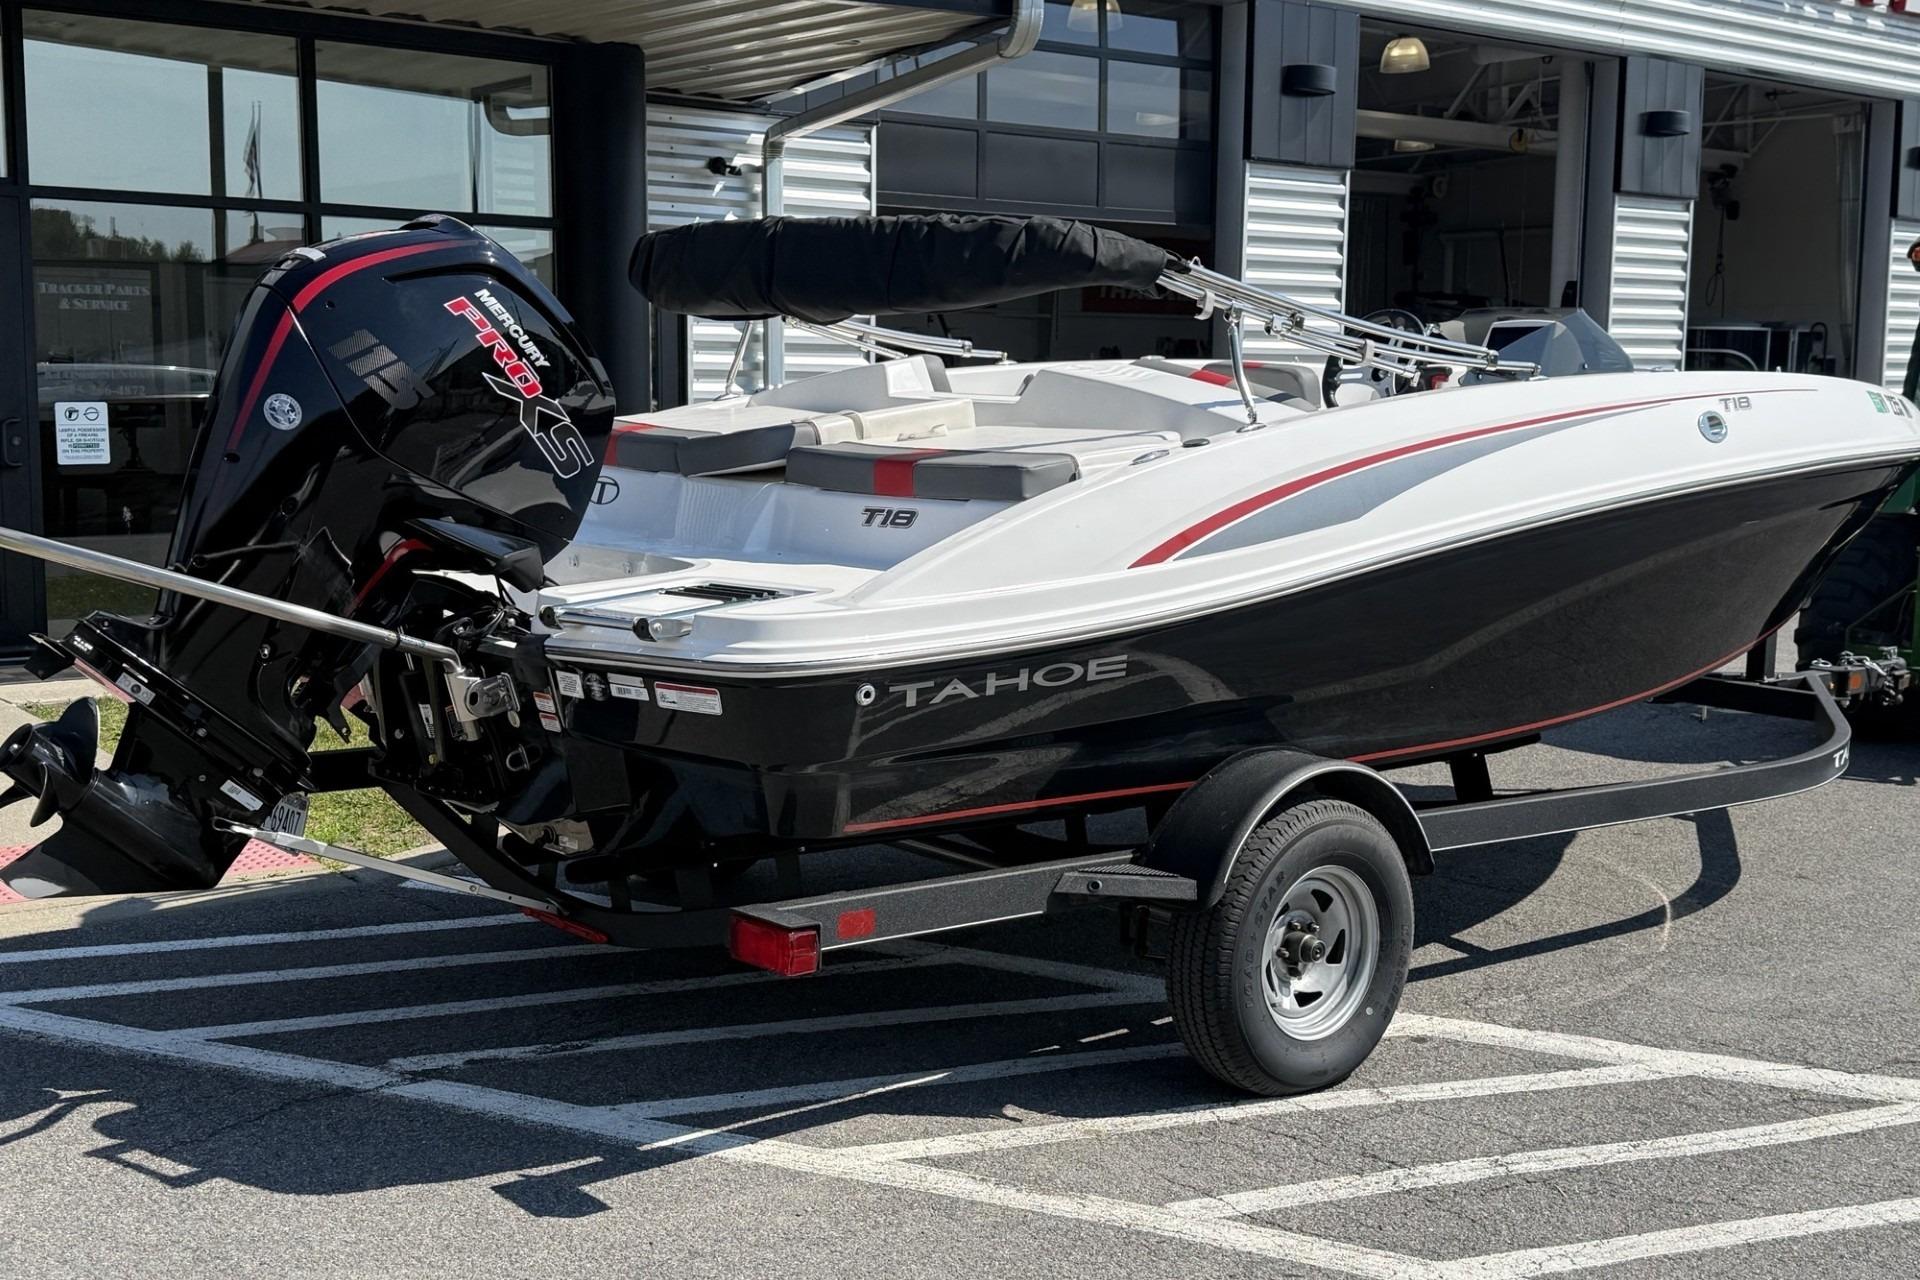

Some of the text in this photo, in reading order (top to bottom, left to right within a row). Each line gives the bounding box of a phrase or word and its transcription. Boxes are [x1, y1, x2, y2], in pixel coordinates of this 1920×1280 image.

[443, 296, 543, 399] PRO
[474, 288, 551, 368] MERCURY
[481, 372, 595, 479] XS
[1718, 396, 1752, 412] T18
[860, 505, 919, 529] T18
[889, 654, 1129, 708] TAHOE
